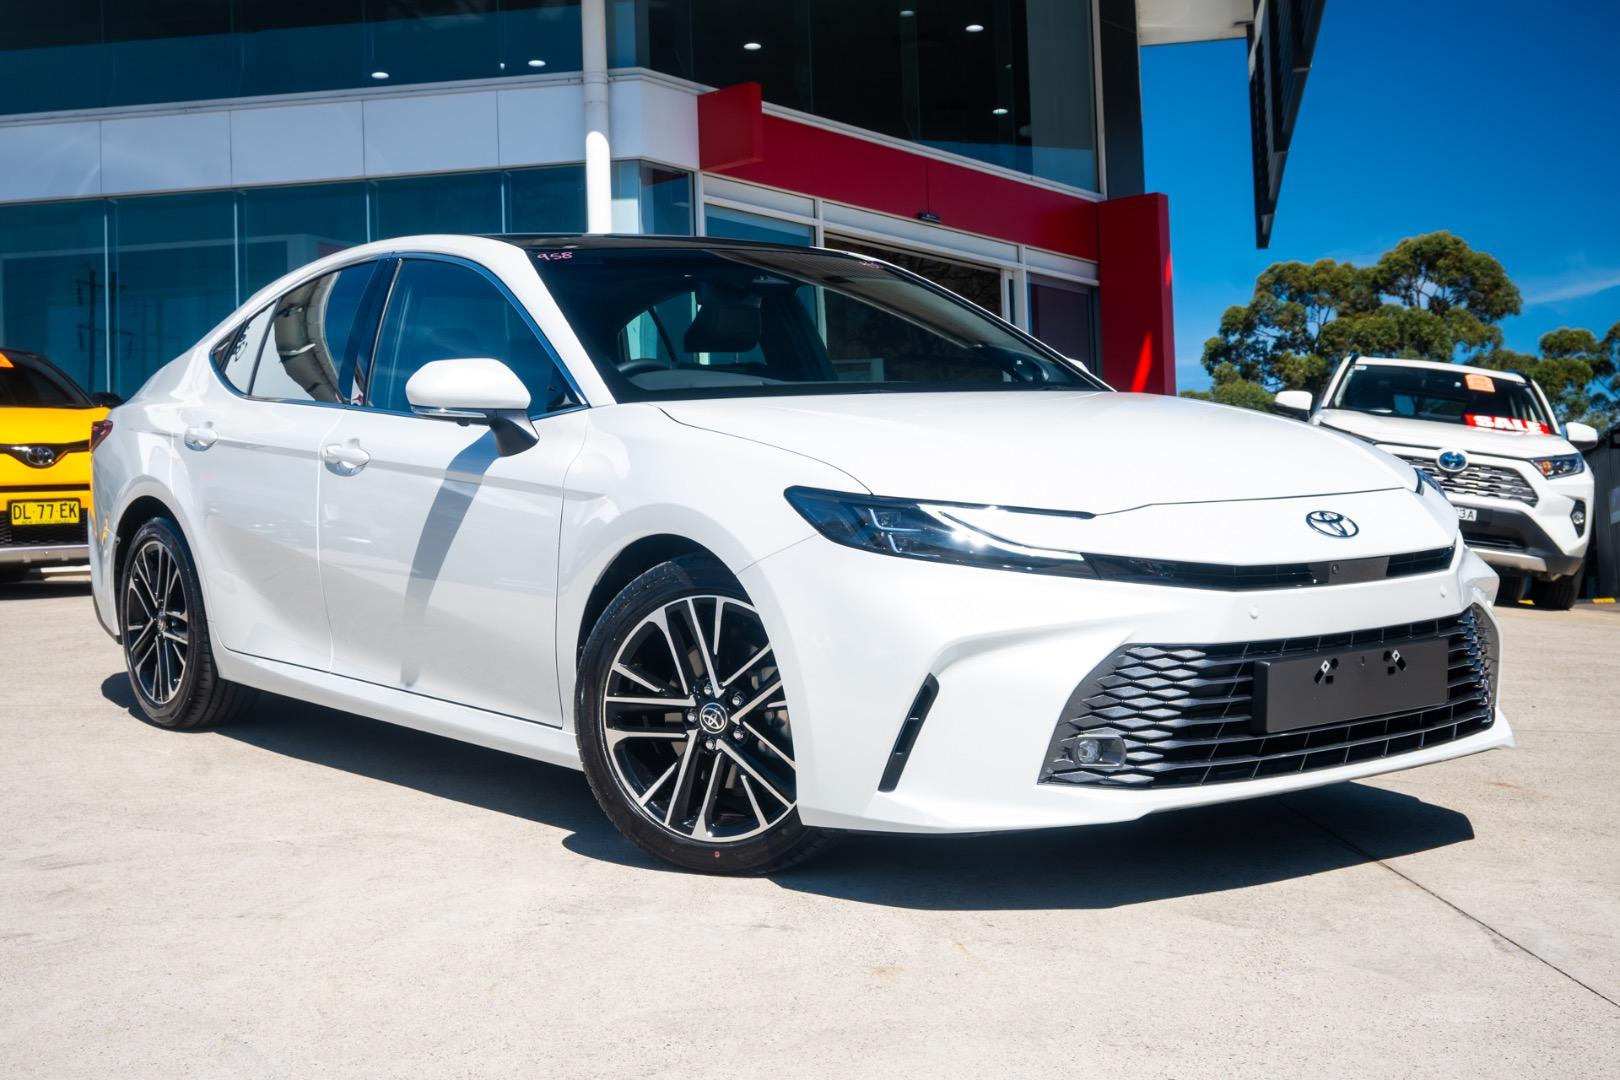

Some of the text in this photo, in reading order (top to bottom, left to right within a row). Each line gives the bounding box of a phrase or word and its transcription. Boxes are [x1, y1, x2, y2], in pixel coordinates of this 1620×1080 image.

[537, 251, 573, 260] 958
[1473, 415, 1545, 434] SALE
[13, 503, 77, 520] DL 77 EK
[1456, 509, 1474, 520] 3A
